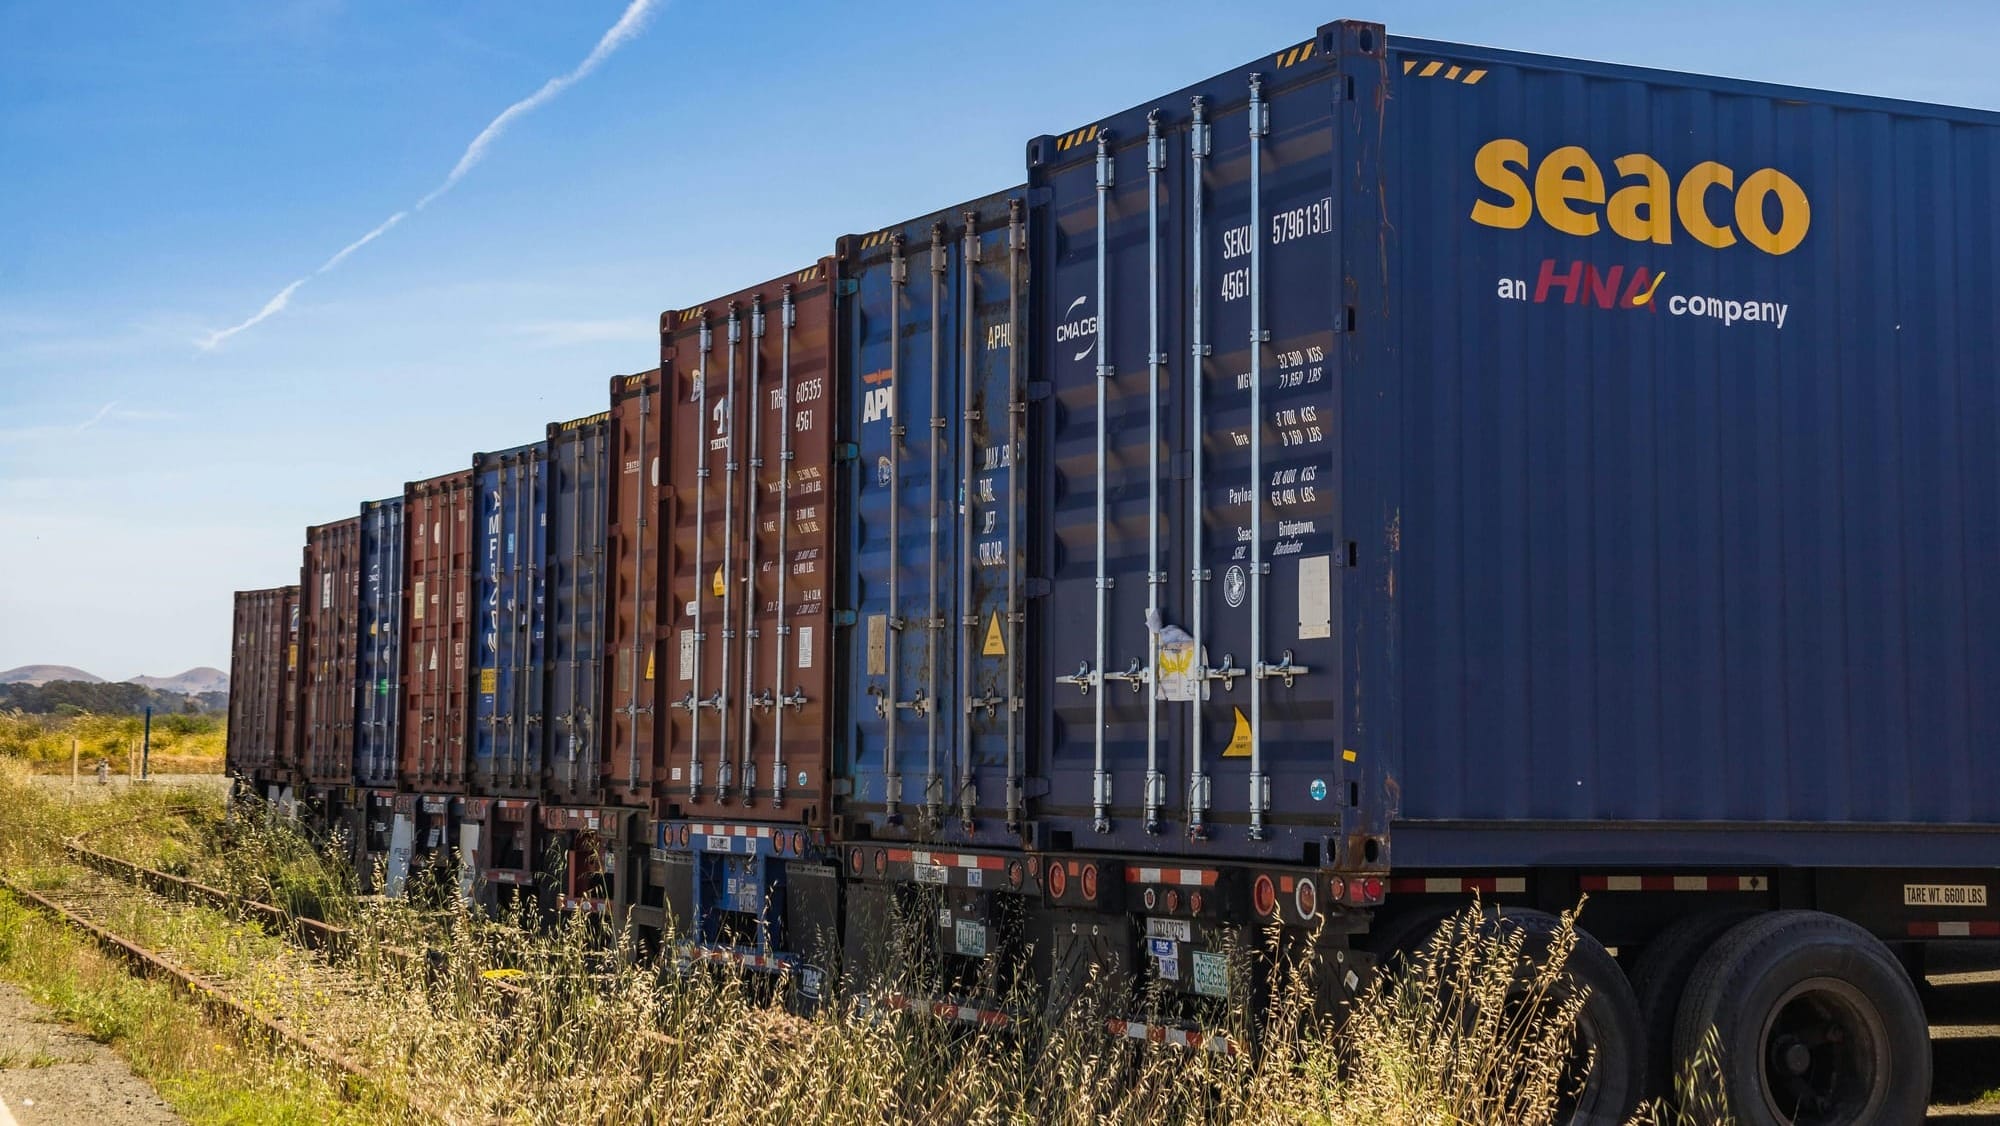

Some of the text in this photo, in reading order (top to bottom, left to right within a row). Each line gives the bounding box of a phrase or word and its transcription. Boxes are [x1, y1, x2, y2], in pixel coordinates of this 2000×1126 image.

[1470, 138, 1810, 255] seaco
[1273, 198, 1331, 244] 5796131
[1221, 267, 1249, 302] 45G1
[1497, 259, 1788, 329] an HNA company
[796, 378, 821, 403] 605355
[1237, 371, 1252, 389] MG
[770, 388, 784, 410] TRH
[796, 410, 812, 432] 45G1
[1300, 406, 1317, 423] KGS
[1231, 432, 1249, 446] Tare
[1229, 487, 1252, 506] Payloa
[1300, 486, 1316, 503] LBS
[1906, 887, 1985, 903] TARE WT. 6600 LBS.
